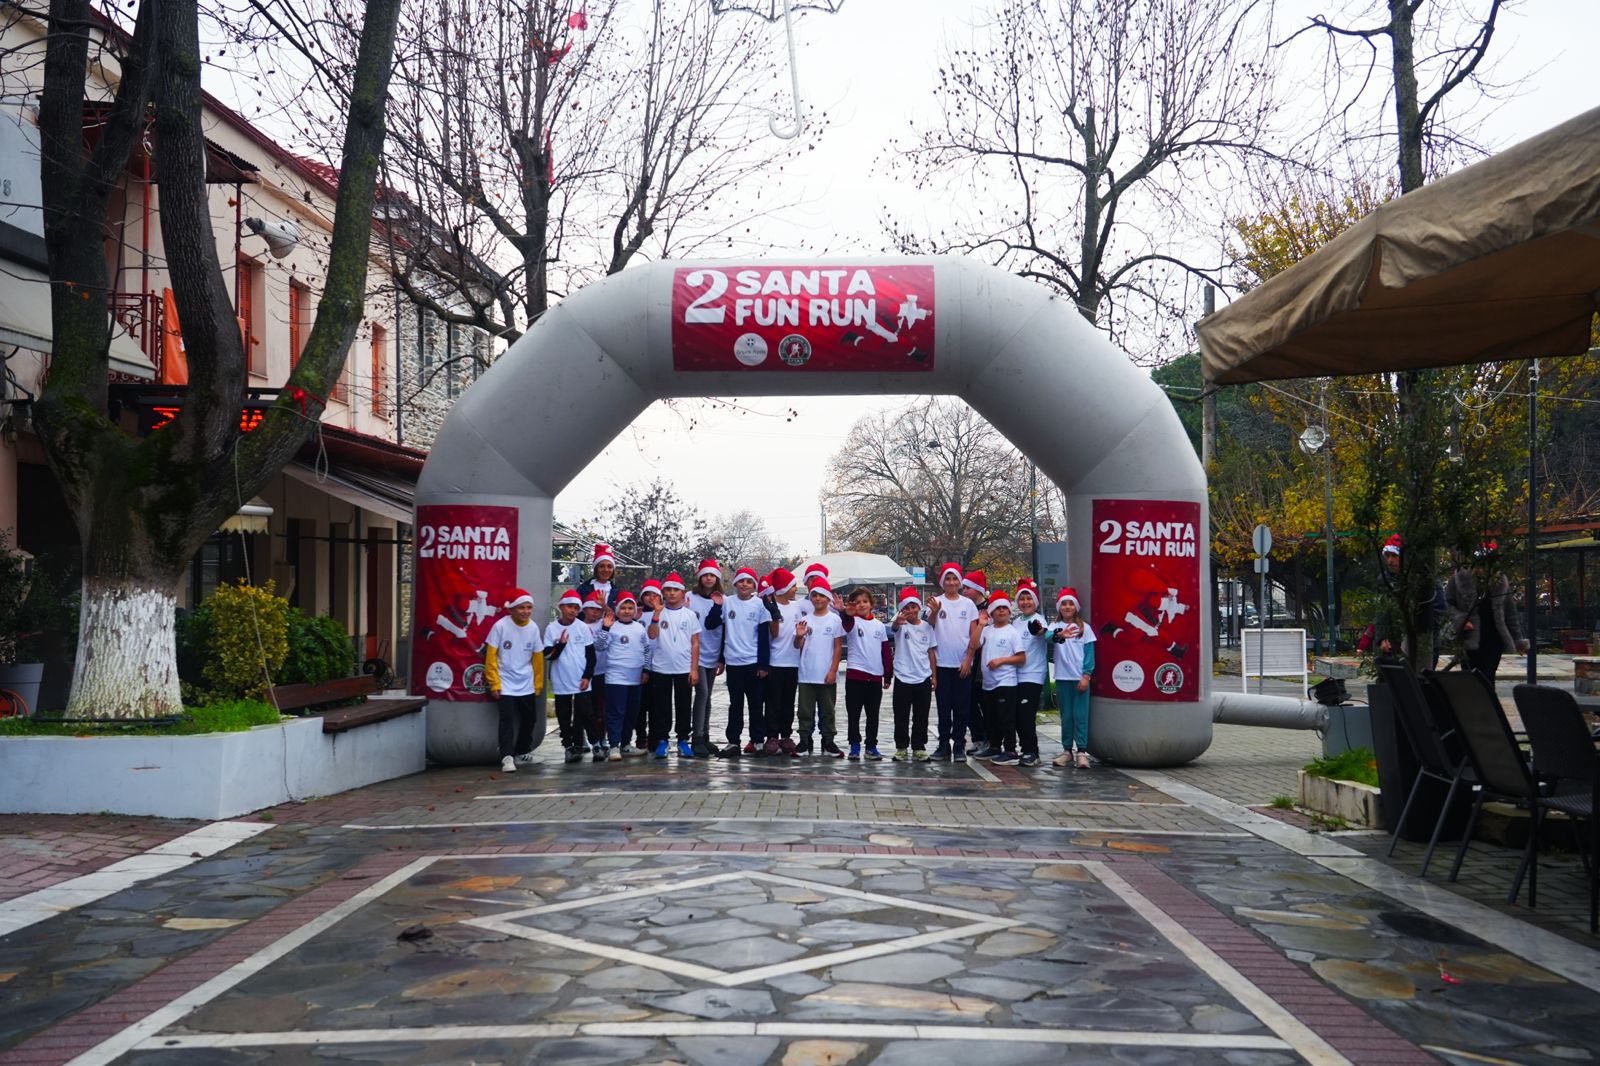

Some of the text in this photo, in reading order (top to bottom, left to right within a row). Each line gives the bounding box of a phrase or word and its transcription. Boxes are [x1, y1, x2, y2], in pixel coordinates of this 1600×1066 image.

[685, 269, 876, 323] 2 SANTA
[735, 298, 876, 327] FUN RUN
[420, 525, 510, 558] 2 SANTA
[1099, 519, 1195, 554] 2 SANTA
[1125, 540, 1196, 557] FUN RUN
[437, 545, 510, 561] FUN RUN
